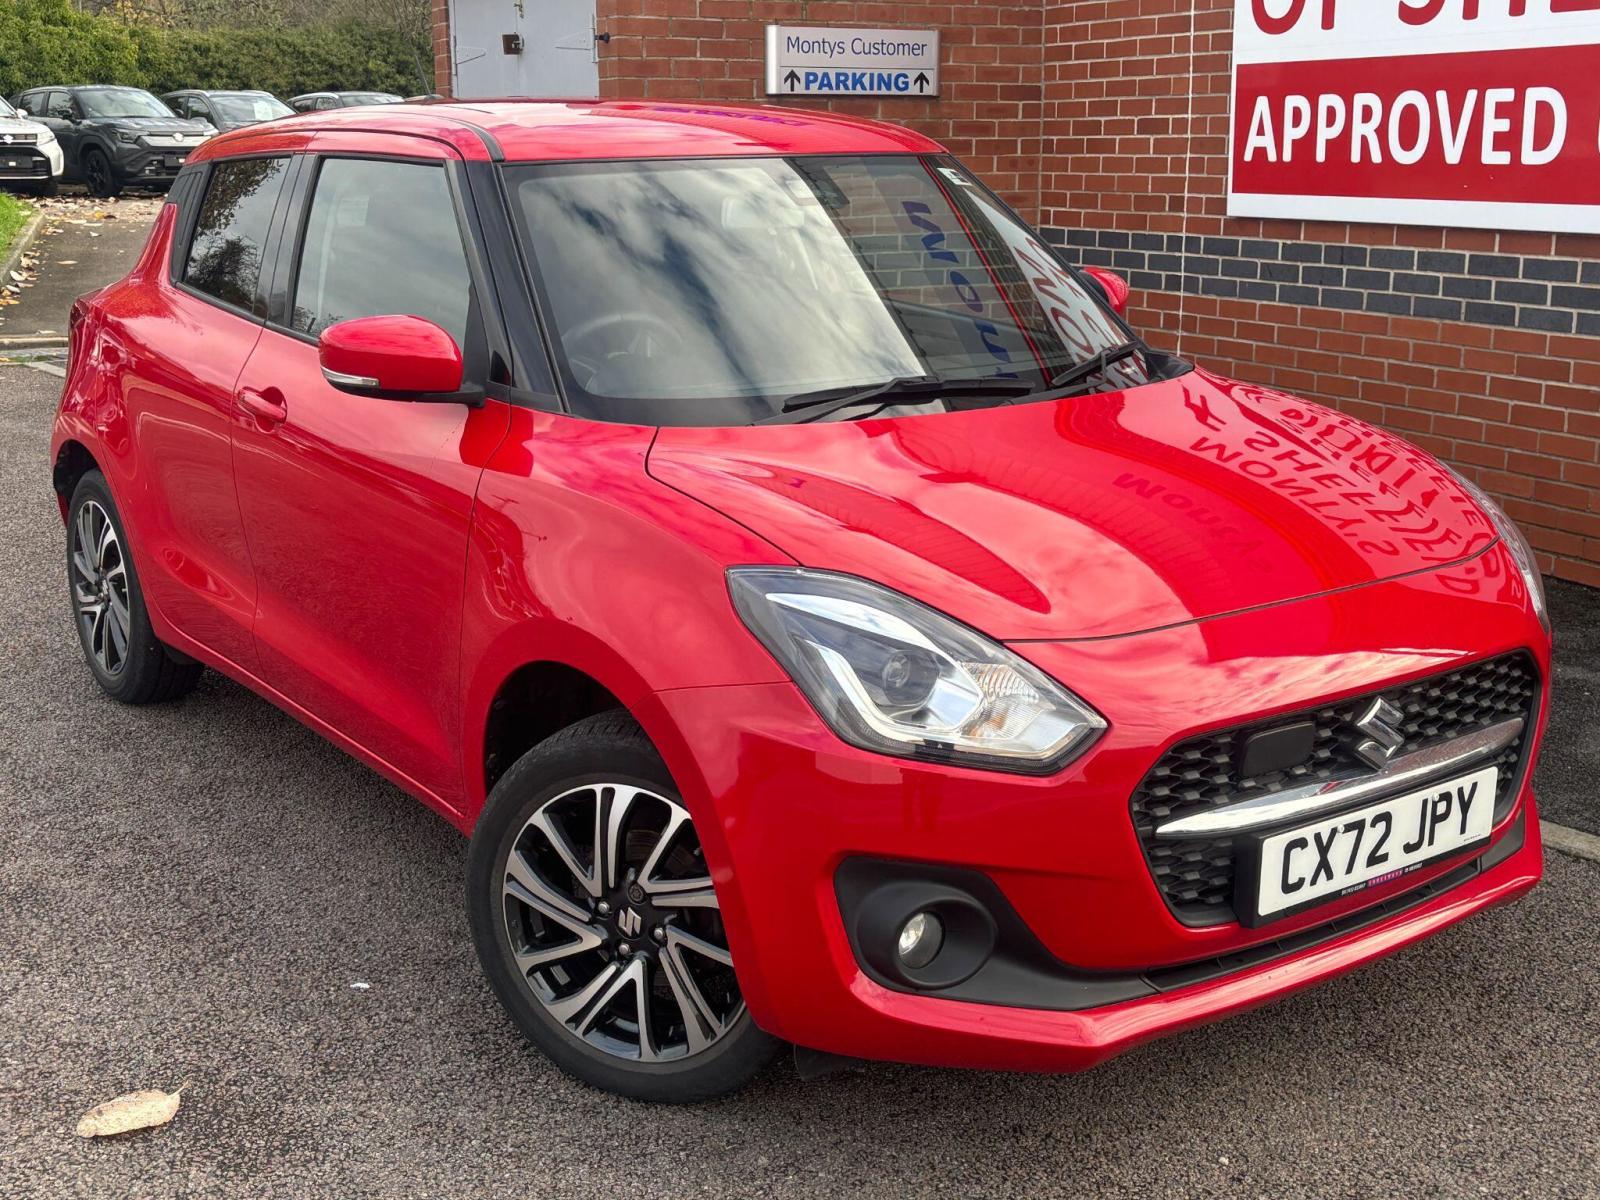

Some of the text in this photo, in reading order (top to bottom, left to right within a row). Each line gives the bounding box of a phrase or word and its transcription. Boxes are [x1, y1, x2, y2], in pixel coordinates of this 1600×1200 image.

[786, 35, 928, 59] Montys Customer
[804, 71, 910, 92] PARKING
[1243, 86, 1568, 166] APPROVED
[1280, 810, 1393, 895] CX72
[1402, 781, 1478, 855] JPY
